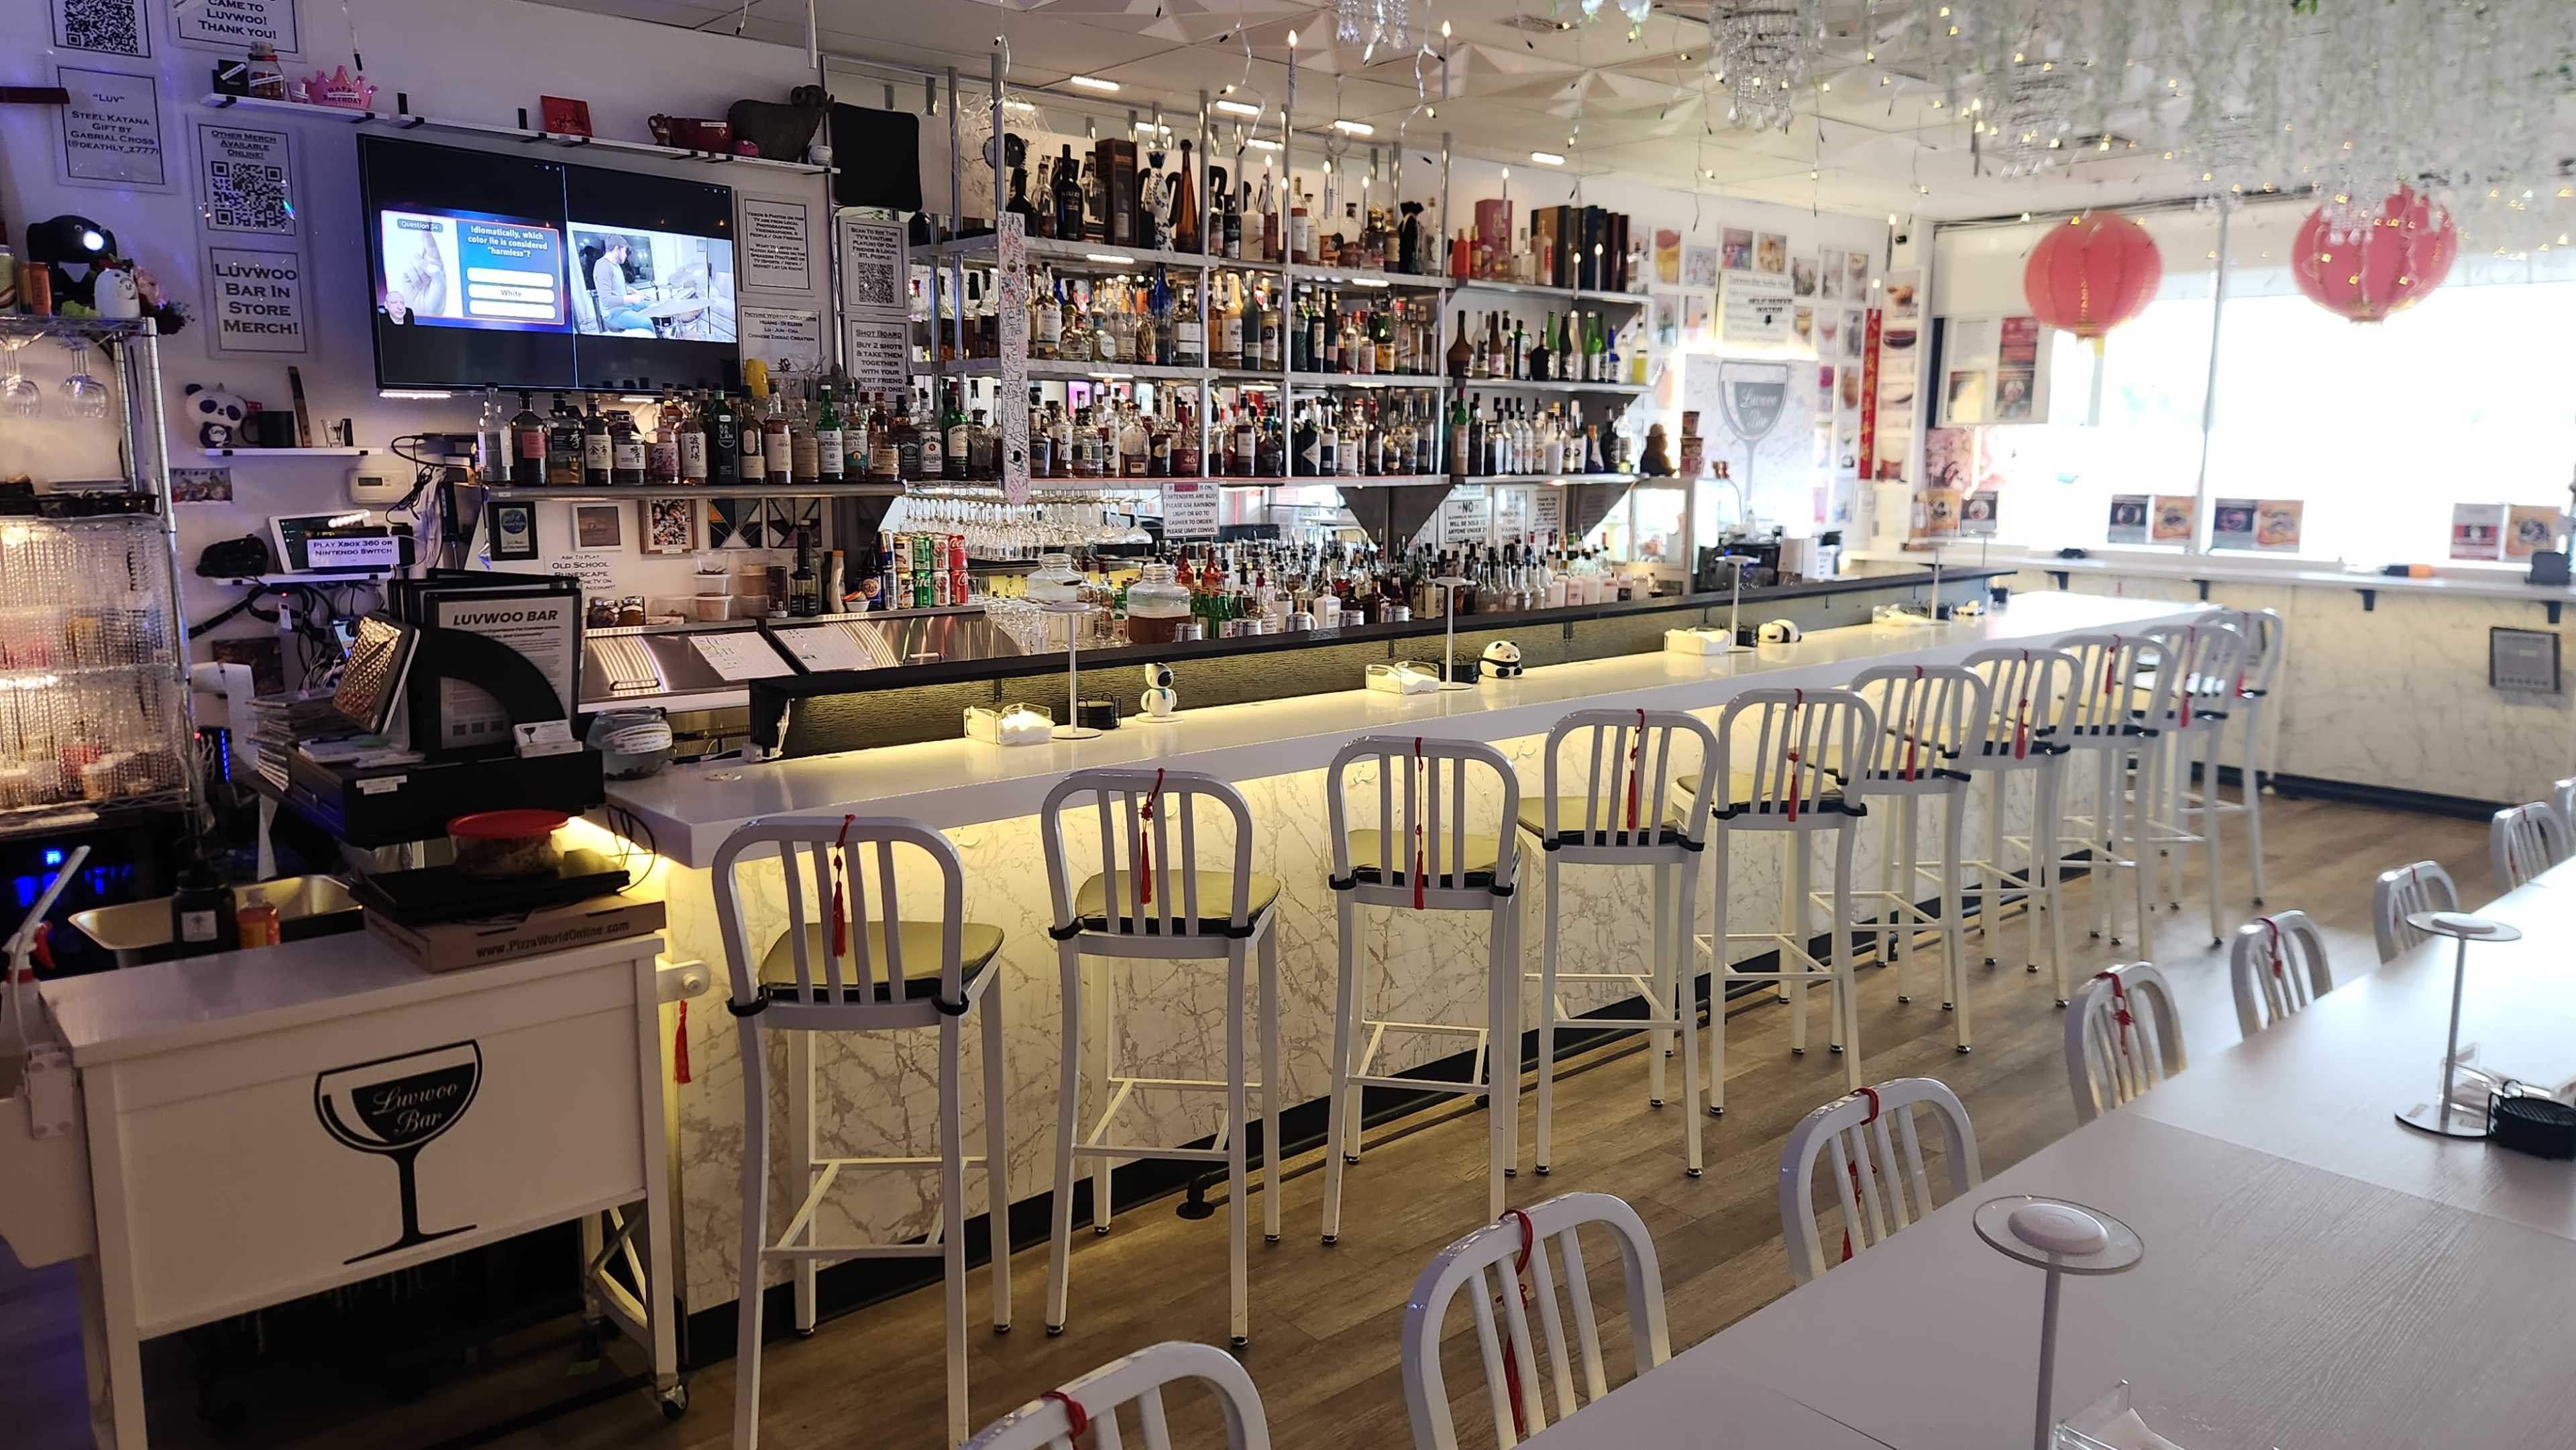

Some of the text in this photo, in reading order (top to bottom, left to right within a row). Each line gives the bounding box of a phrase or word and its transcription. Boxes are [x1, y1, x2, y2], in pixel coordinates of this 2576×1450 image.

[199, 19, 276, 39] THANK YOU!
[71, 111, 105, 121] STEEL
[92, 123, 116, 131] GIFT
[119, 135, 154, 145] CROSS
[221, 140, 270, 151] AVAILABLE
[401, 221, 429, 230] Question
[468, 235, 487, 245] color
[508, 239, 547, 250] considered
[523, 231, 544, 241] which
[215, 264, 297, 280] LUVWOO
[225, 283, 290, 298] BAR IN
[229, 301, 291, 316] STORE
[223, 319, 299, 335] MERCH!
[1185, 455, 1195, 464] 46
[453, 610, 558, 626] LUVWOO BAR
[372, 1083, 459, 1115] Luvwoo
[394, 1109, 443, 1133] Bar
